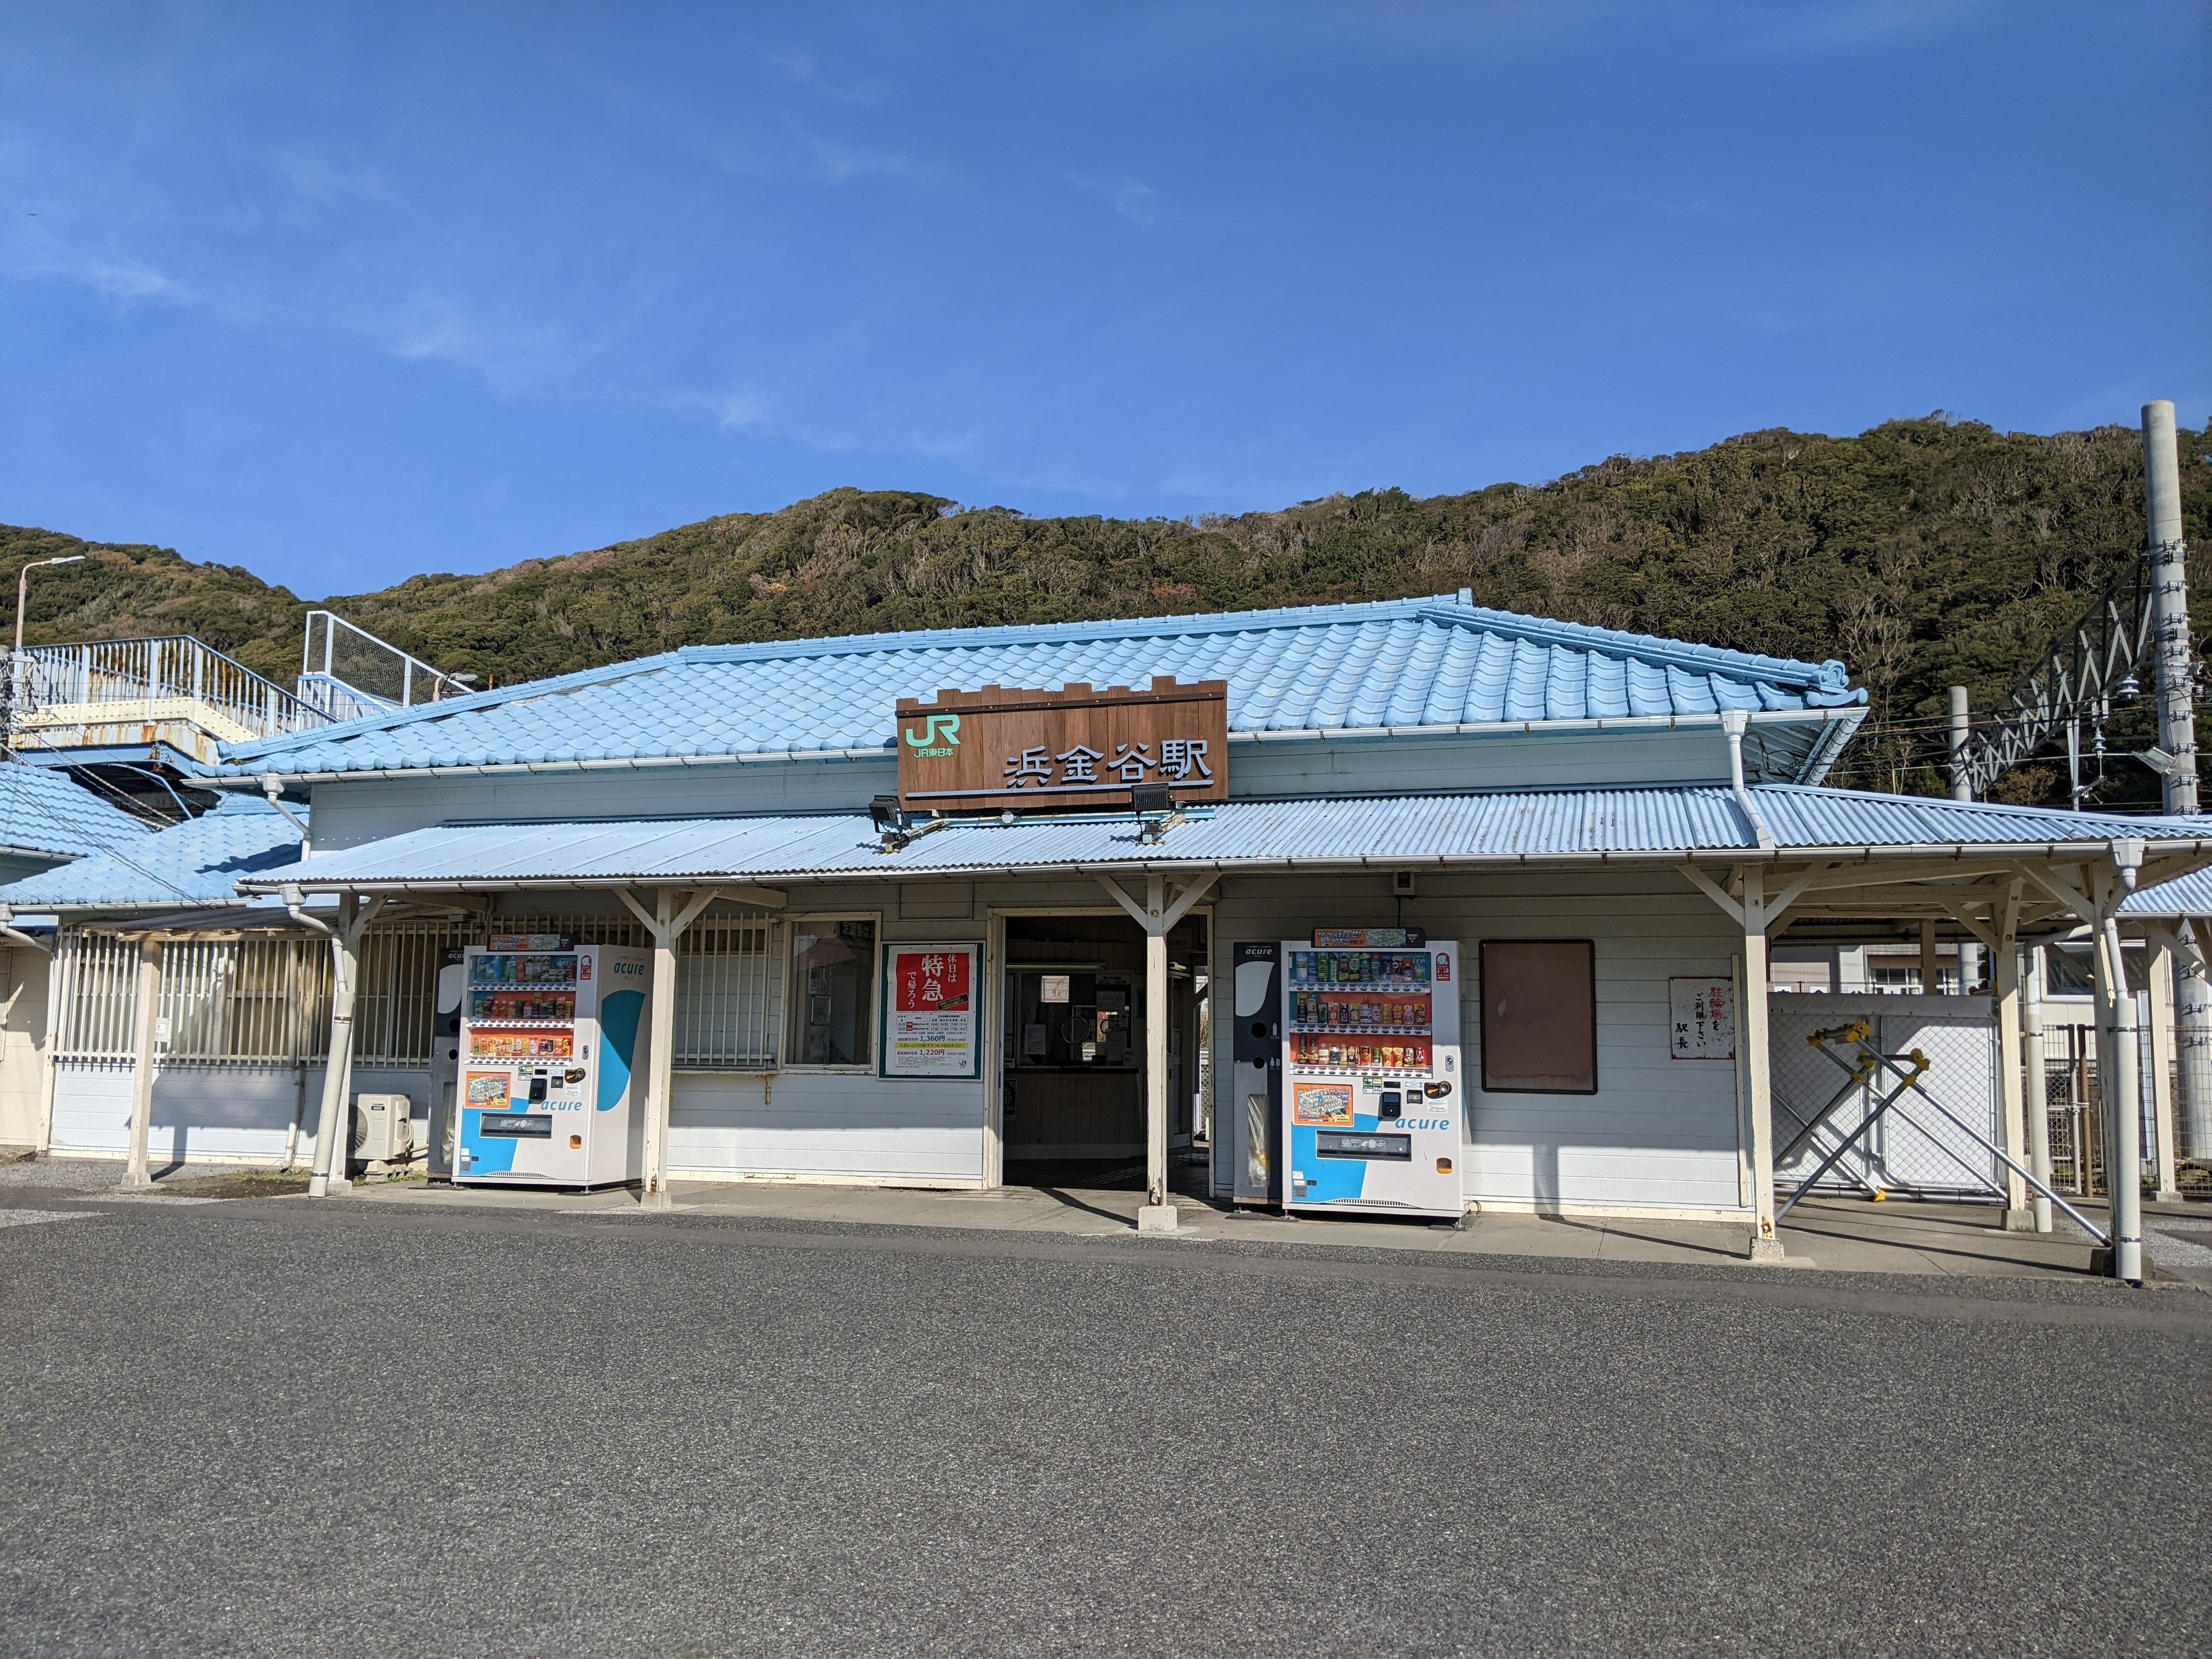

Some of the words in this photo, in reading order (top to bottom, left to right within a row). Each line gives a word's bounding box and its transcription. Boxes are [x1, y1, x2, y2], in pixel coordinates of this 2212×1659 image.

[905, 714, 961, 748] JR
[913, 748, 955, 759] JR東日本
[1004, 739, 1212, 787] 浜金谷駅
[614, 962, 645, 975] acure
[921, 954, 944, 1001] 特急
[947, 954, 957, 983] 休日は
[907, 972, 917, 1008] で帰ろう
[1694, 992, 1707, 1047] ご利用下さい
[1709, 987, 1725, 1031] 駐輪場を
[1674, 1022, 1689, 1049] 駅長
[541, 1100, 582, 1111] acure
[1395, 1118, 1449, 1130] acure
